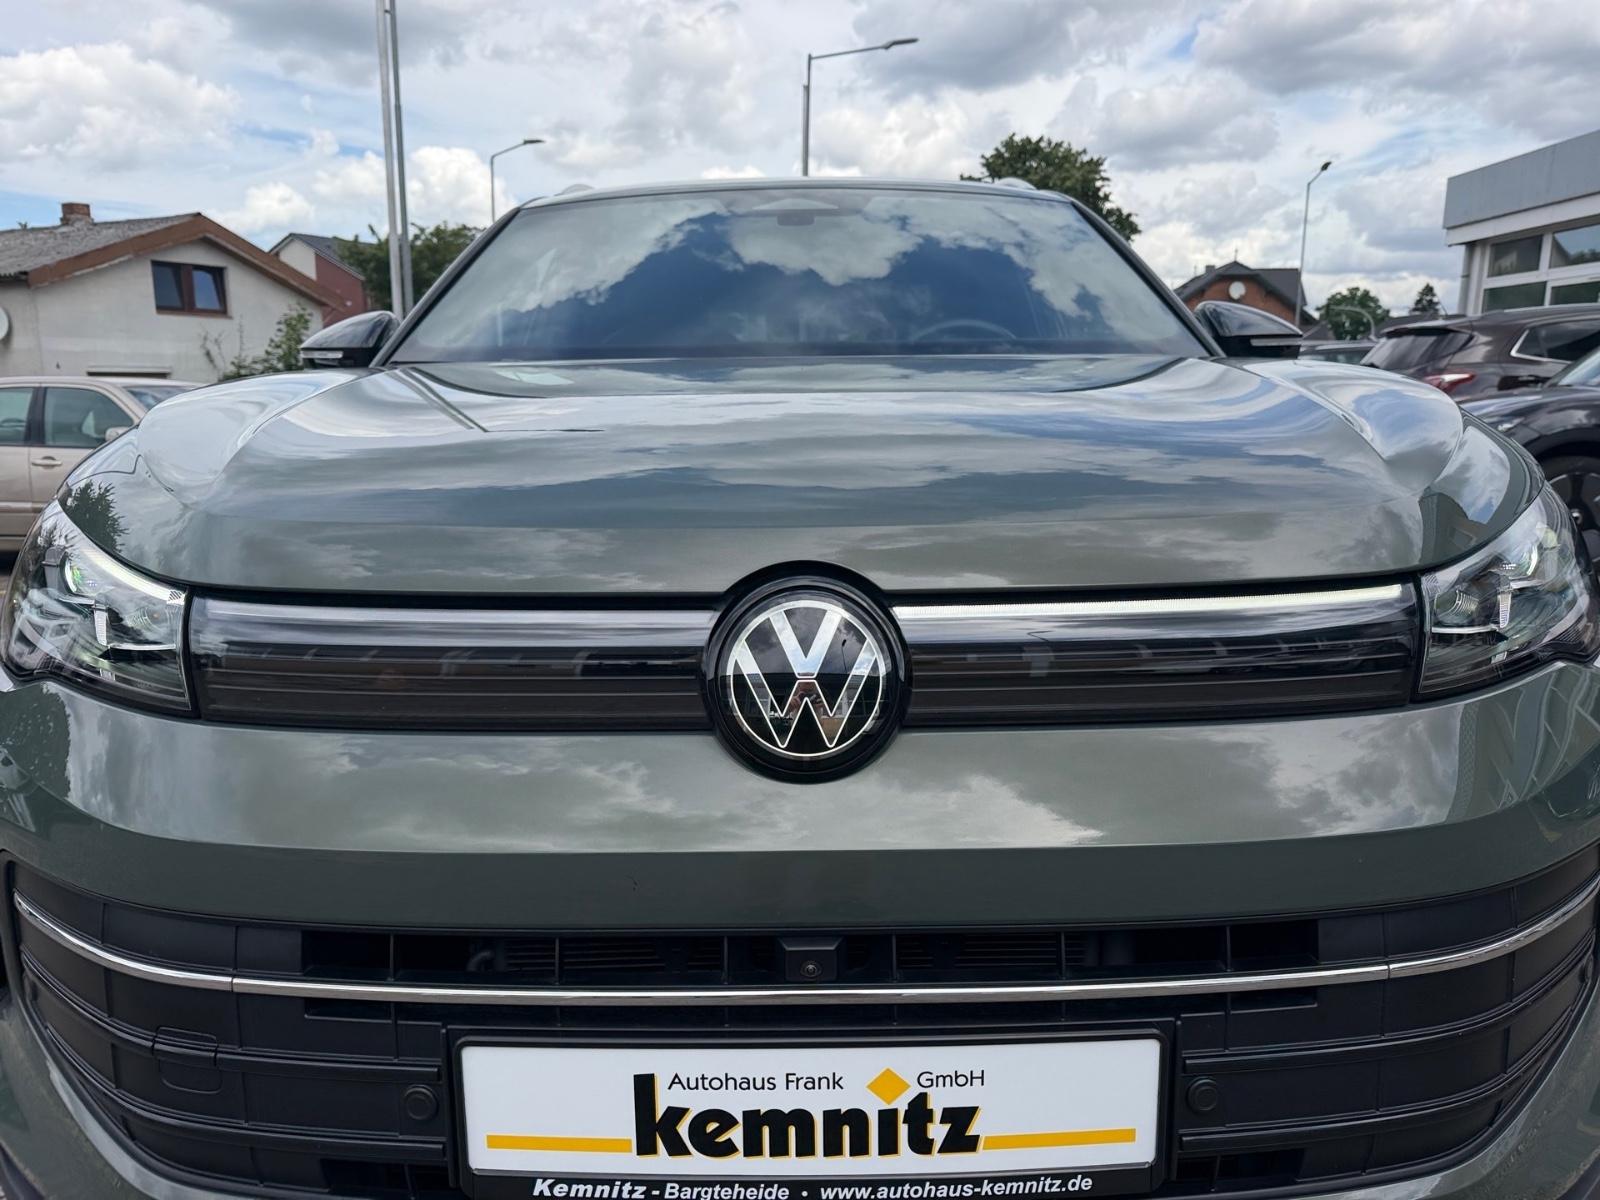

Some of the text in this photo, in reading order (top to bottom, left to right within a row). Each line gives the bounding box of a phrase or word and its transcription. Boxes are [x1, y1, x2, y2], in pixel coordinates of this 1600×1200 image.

[667, 1069, 985, 1091] Autohaus Frank GmbH
[633, 1071, 982, 1159] kemnitz
[532, 1178, 647, 1199] Kemnitz
[664, 1182, 790, 1200] Bargteheide
[820, 1174, 1093, 1200] www.autohaus-kemnitz.de
